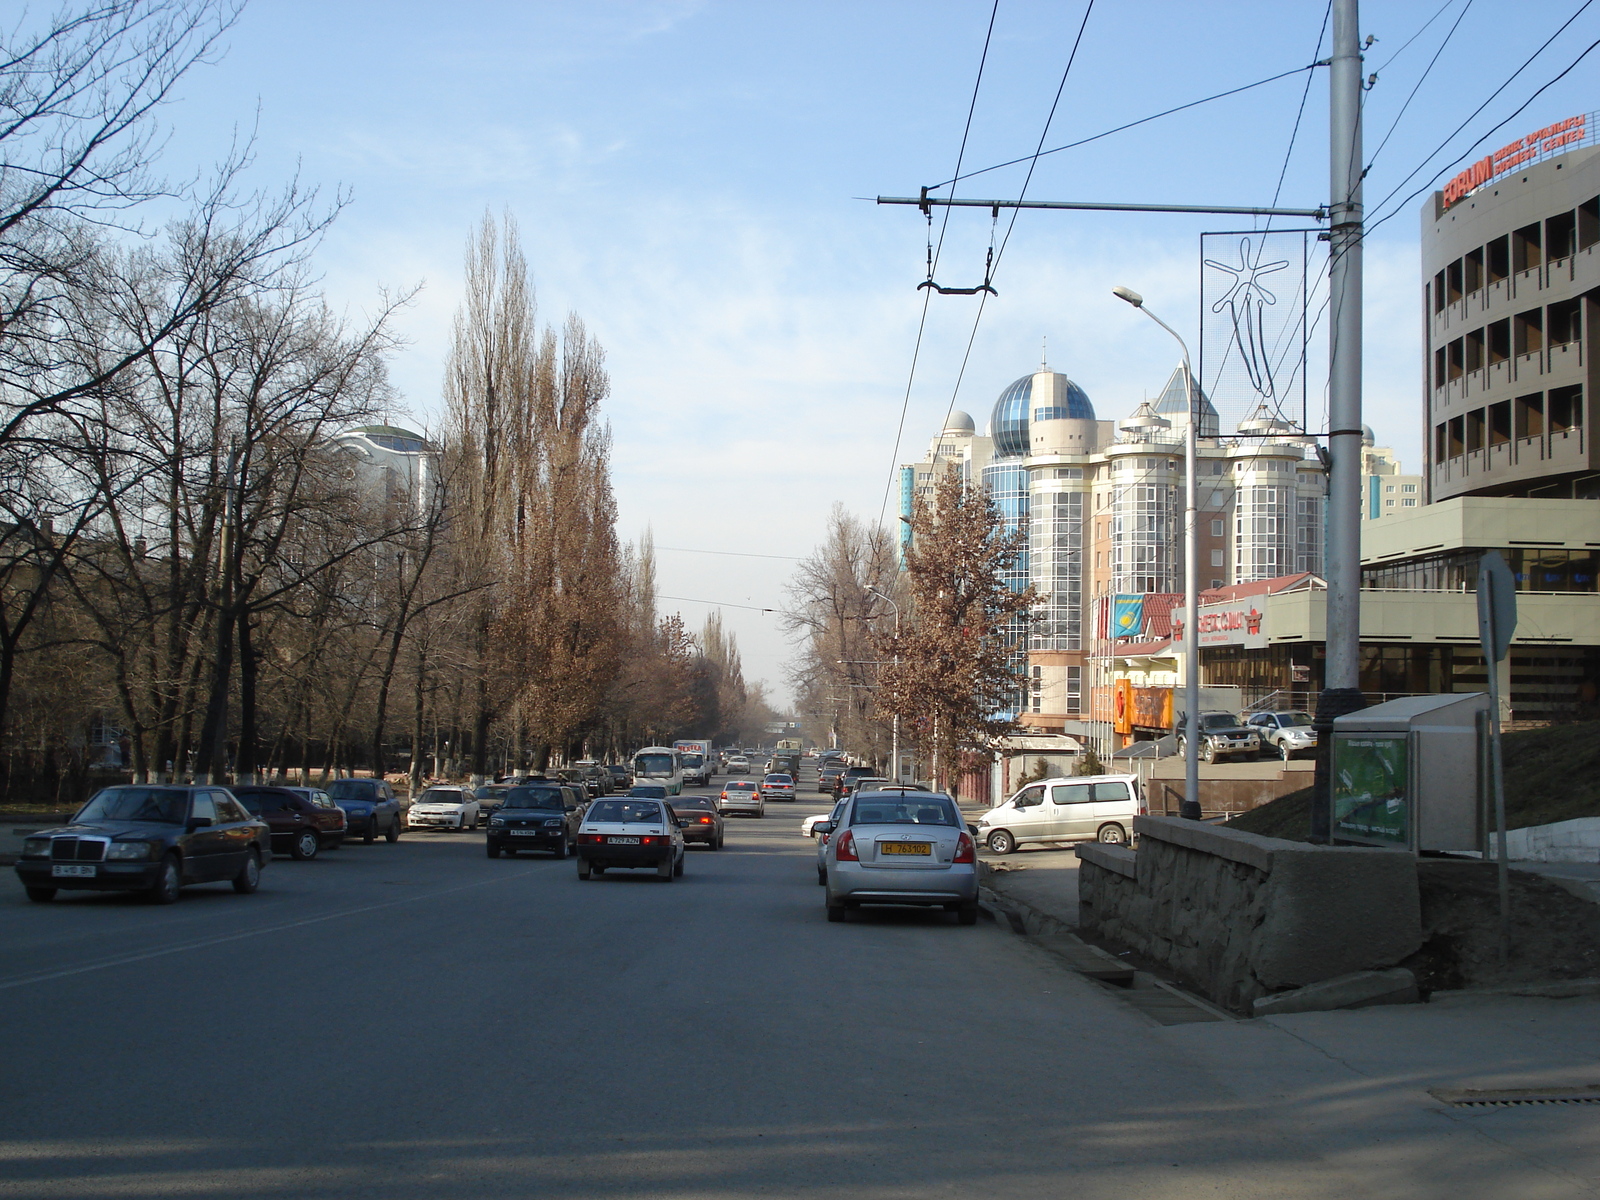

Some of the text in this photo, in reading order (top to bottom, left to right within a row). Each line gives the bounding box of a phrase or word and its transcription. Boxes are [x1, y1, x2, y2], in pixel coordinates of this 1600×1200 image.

[1493, 138, 1524, 162] БИЗНЕС
[1493, 128, 1585, 176] BUSINESS CENTER
[1443, 155, 1493, 208] FORUM
[897, 845, 927, 853] 763102
